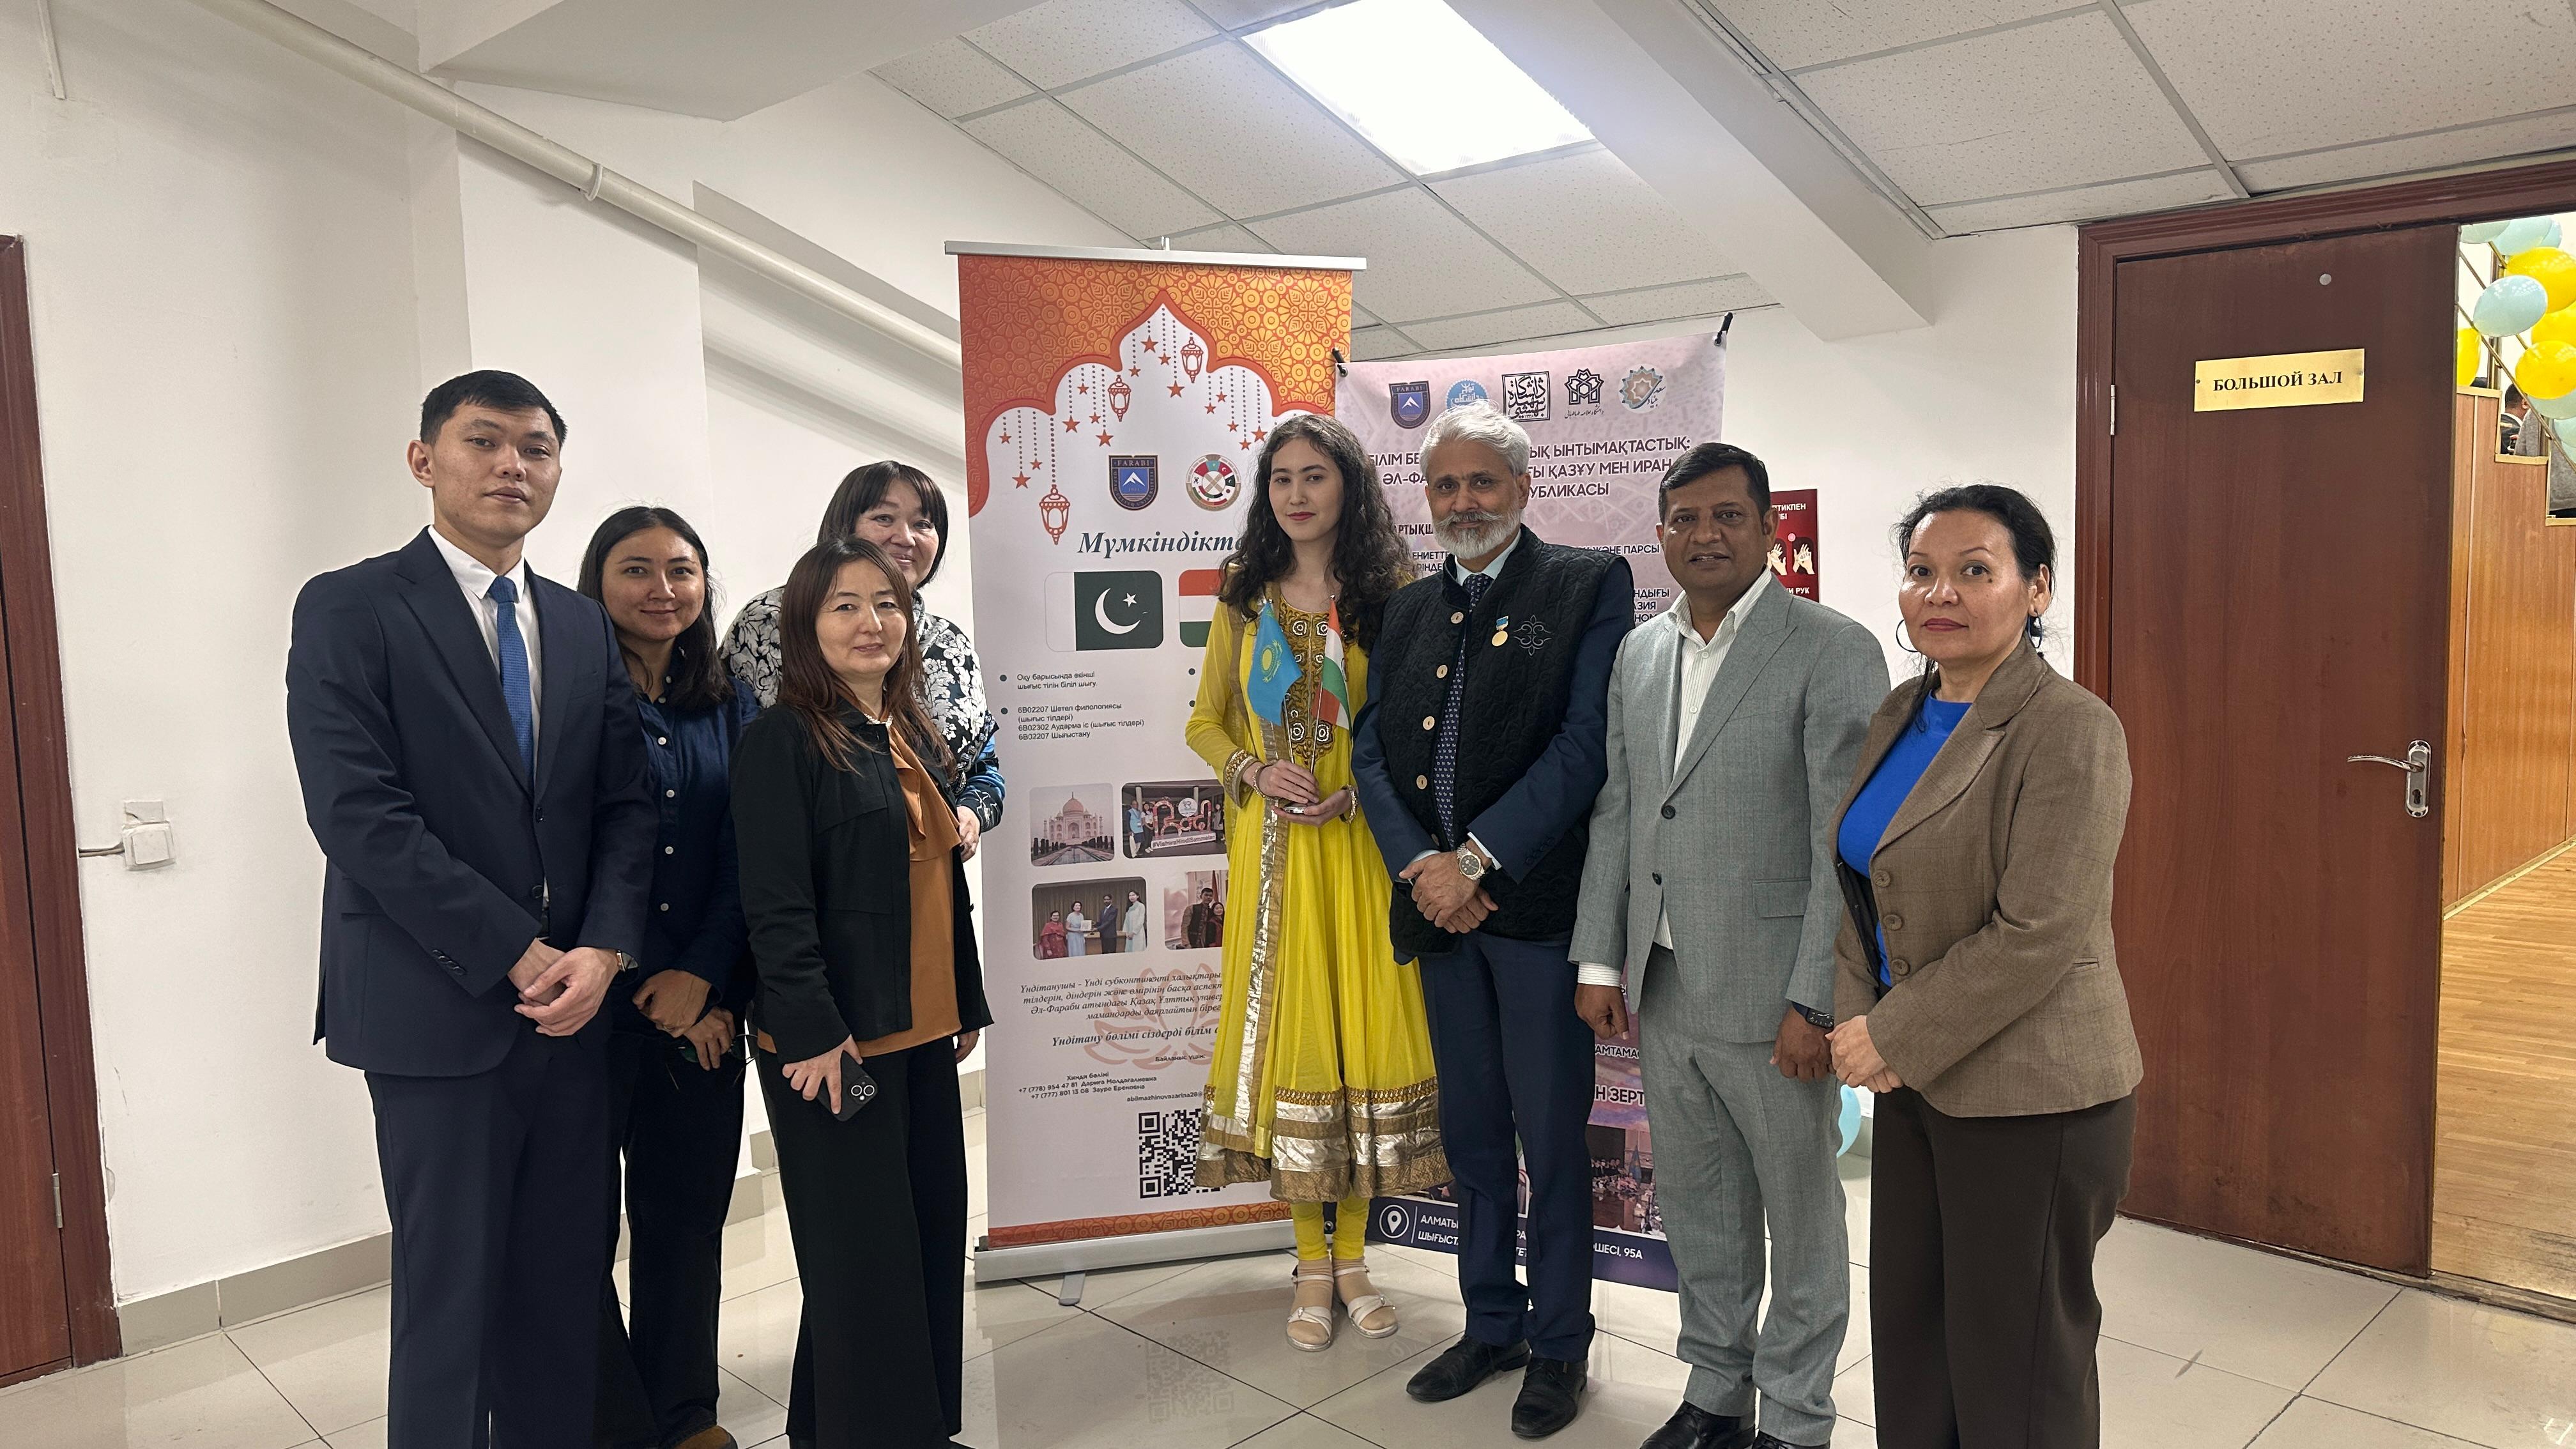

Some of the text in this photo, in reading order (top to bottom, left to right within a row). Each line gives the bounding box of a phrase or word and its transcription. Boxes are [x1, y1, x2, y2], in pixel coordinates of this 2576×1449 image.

[2212, 371, 2343, 392] БОЛЬШОЙ ЗАЛ
[1554, 436, 1690, 458] ЫНТЫМАҚТАСТЫҚ:
[1548, 463, 1596, 480] ҚАЗҰУ
[1599, 461, 1629, 475] МЕН
[1633, 458, 1672, 473] ИРАН
[1623, 544, 1660, 555] ПАРСЫ
[1052, 1034, 1103, 1046] Үндітану
[1184, 1025, 1211, 1036] білім
[1610, 1087, 1644, 1105] ЗЕРТ
[1418, 1230, 1459, 1246] ШЫҒЫСТ
[1593, 1242, 1621, 1257] ШЕСІ,
[1623, 1247, 1643, 1259] 95А
